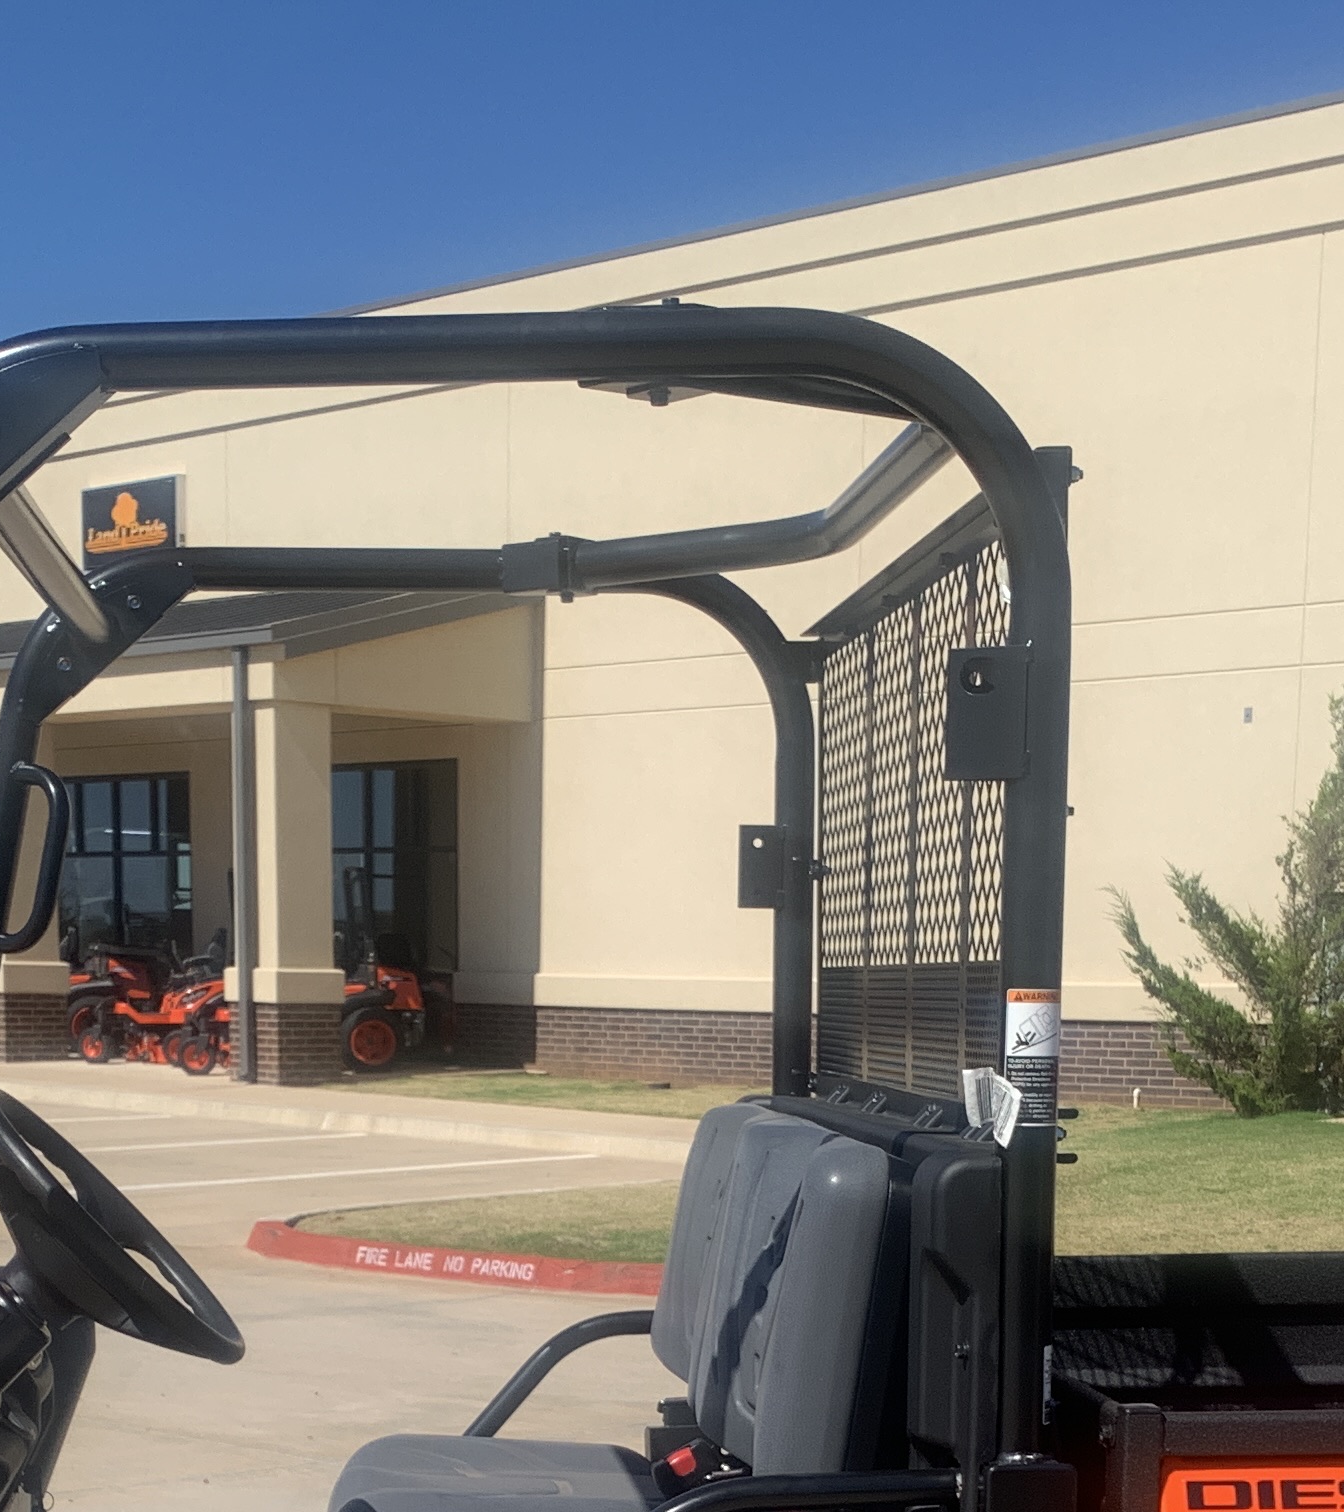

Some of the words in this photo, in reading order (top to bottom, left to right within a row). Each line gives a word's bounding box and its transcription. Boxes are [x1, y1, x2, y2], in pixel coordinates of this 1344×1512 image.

[355, 1246, 389, 1267] FIRE
[394, 1250, 434, 1271] LANE
[443, 1255, 466, 1273] NO
[470, 1258, 536, 1281] PARKING
